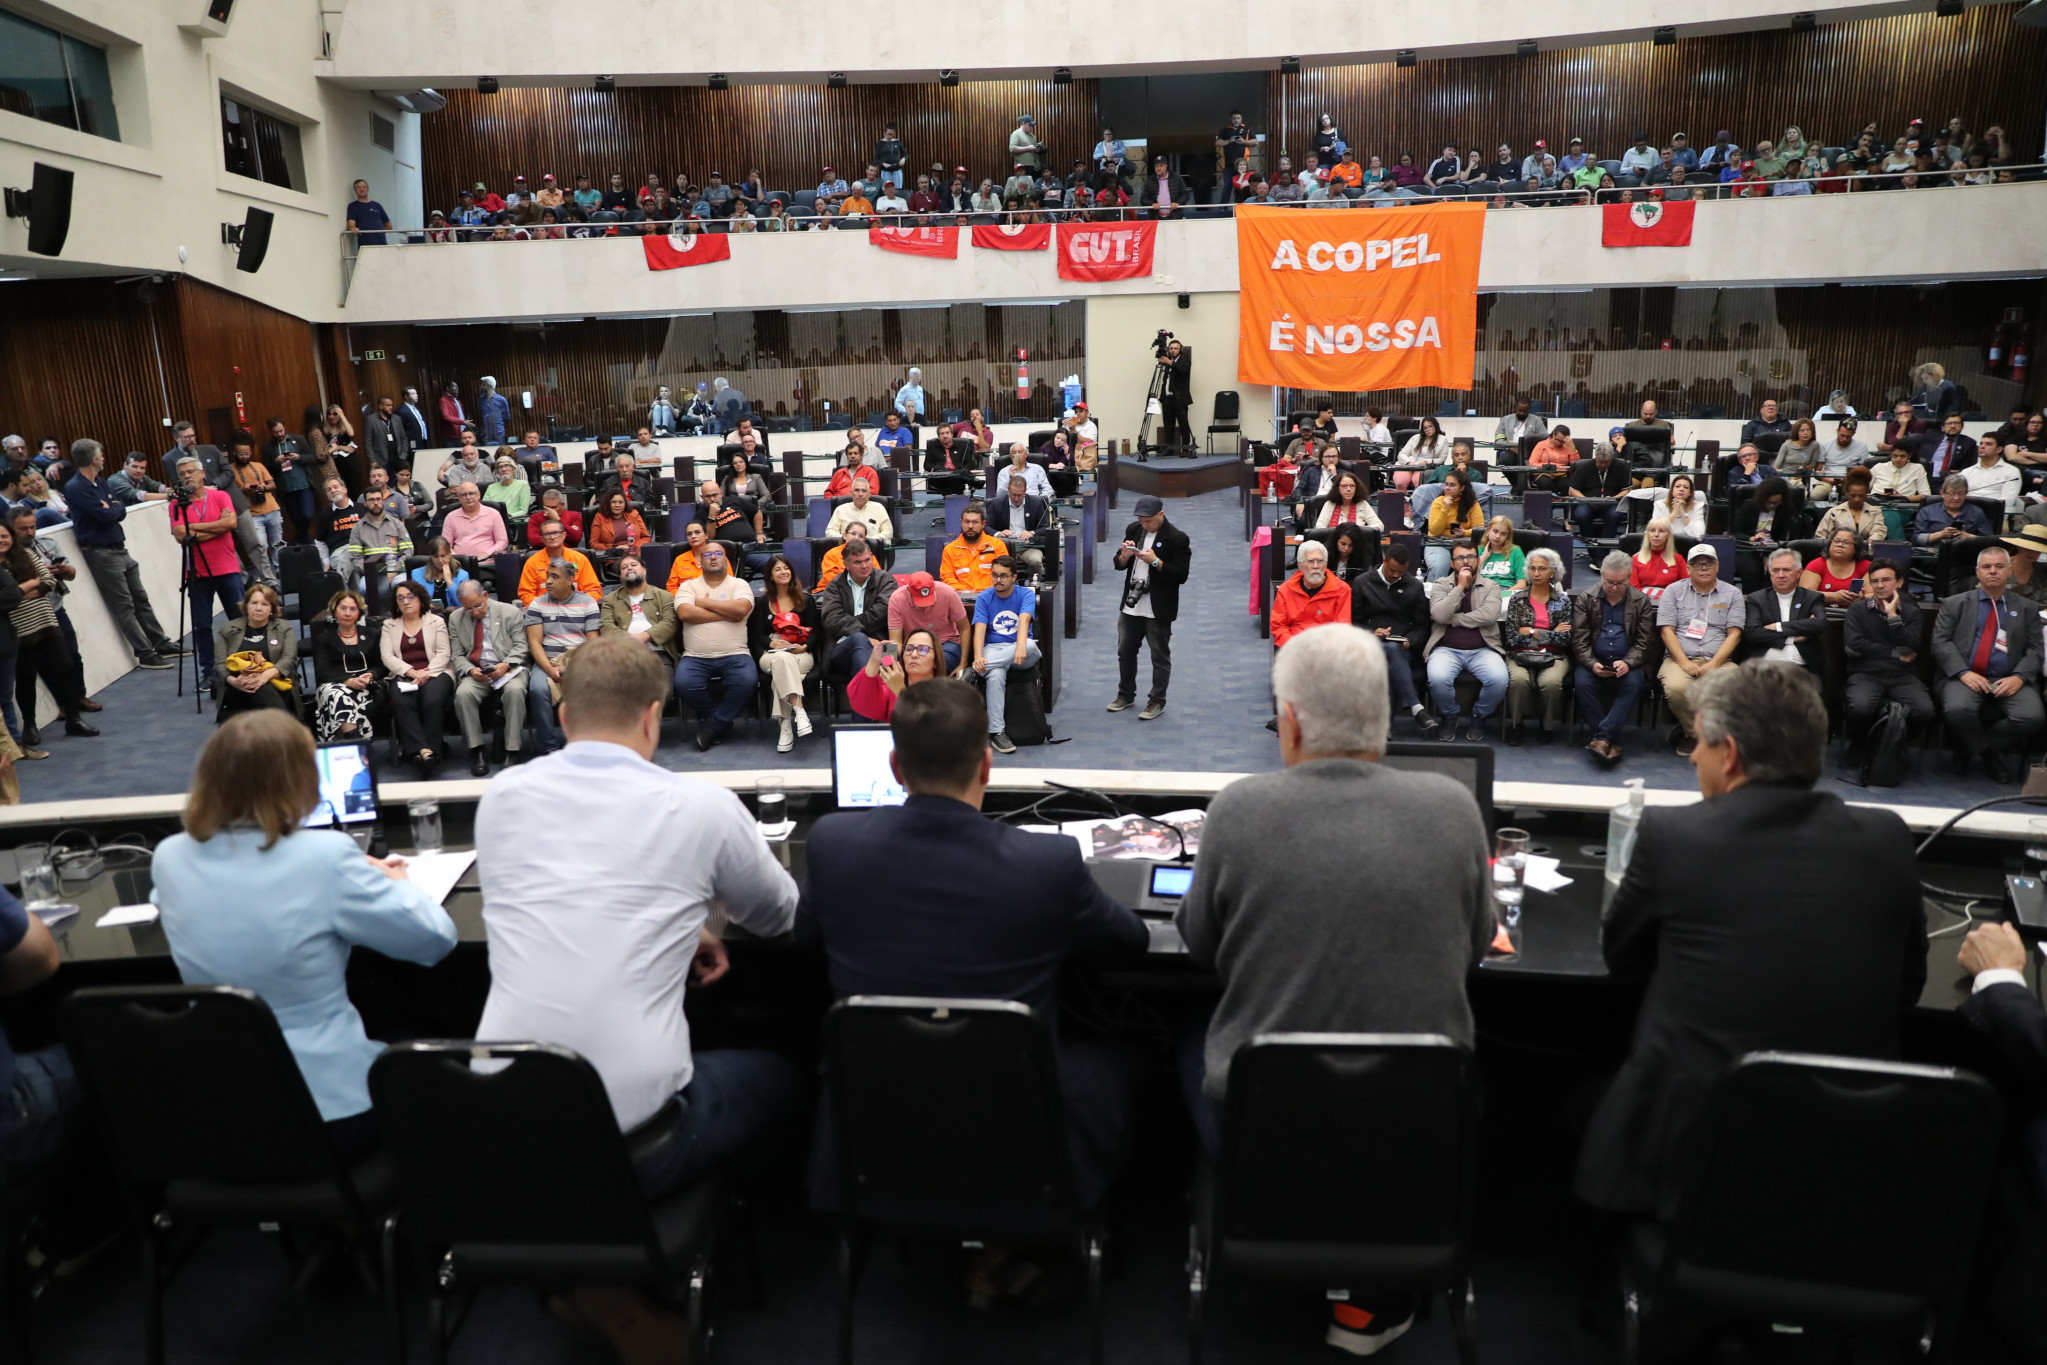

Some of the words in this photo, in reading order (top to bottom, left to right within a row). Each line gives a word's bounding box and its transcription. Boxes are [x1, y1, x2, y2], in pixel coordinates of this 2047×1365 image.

[1069, 230, 1134, 263] CUT
[1132, 227, 1143, 263] BRASIL
[1270, 239, 1302, 270] A
[1306, 233, 1441, 272] COPEL
[1269, 312, 1295, 352] É
[1305, 316, 1442, 354] NOSSA
